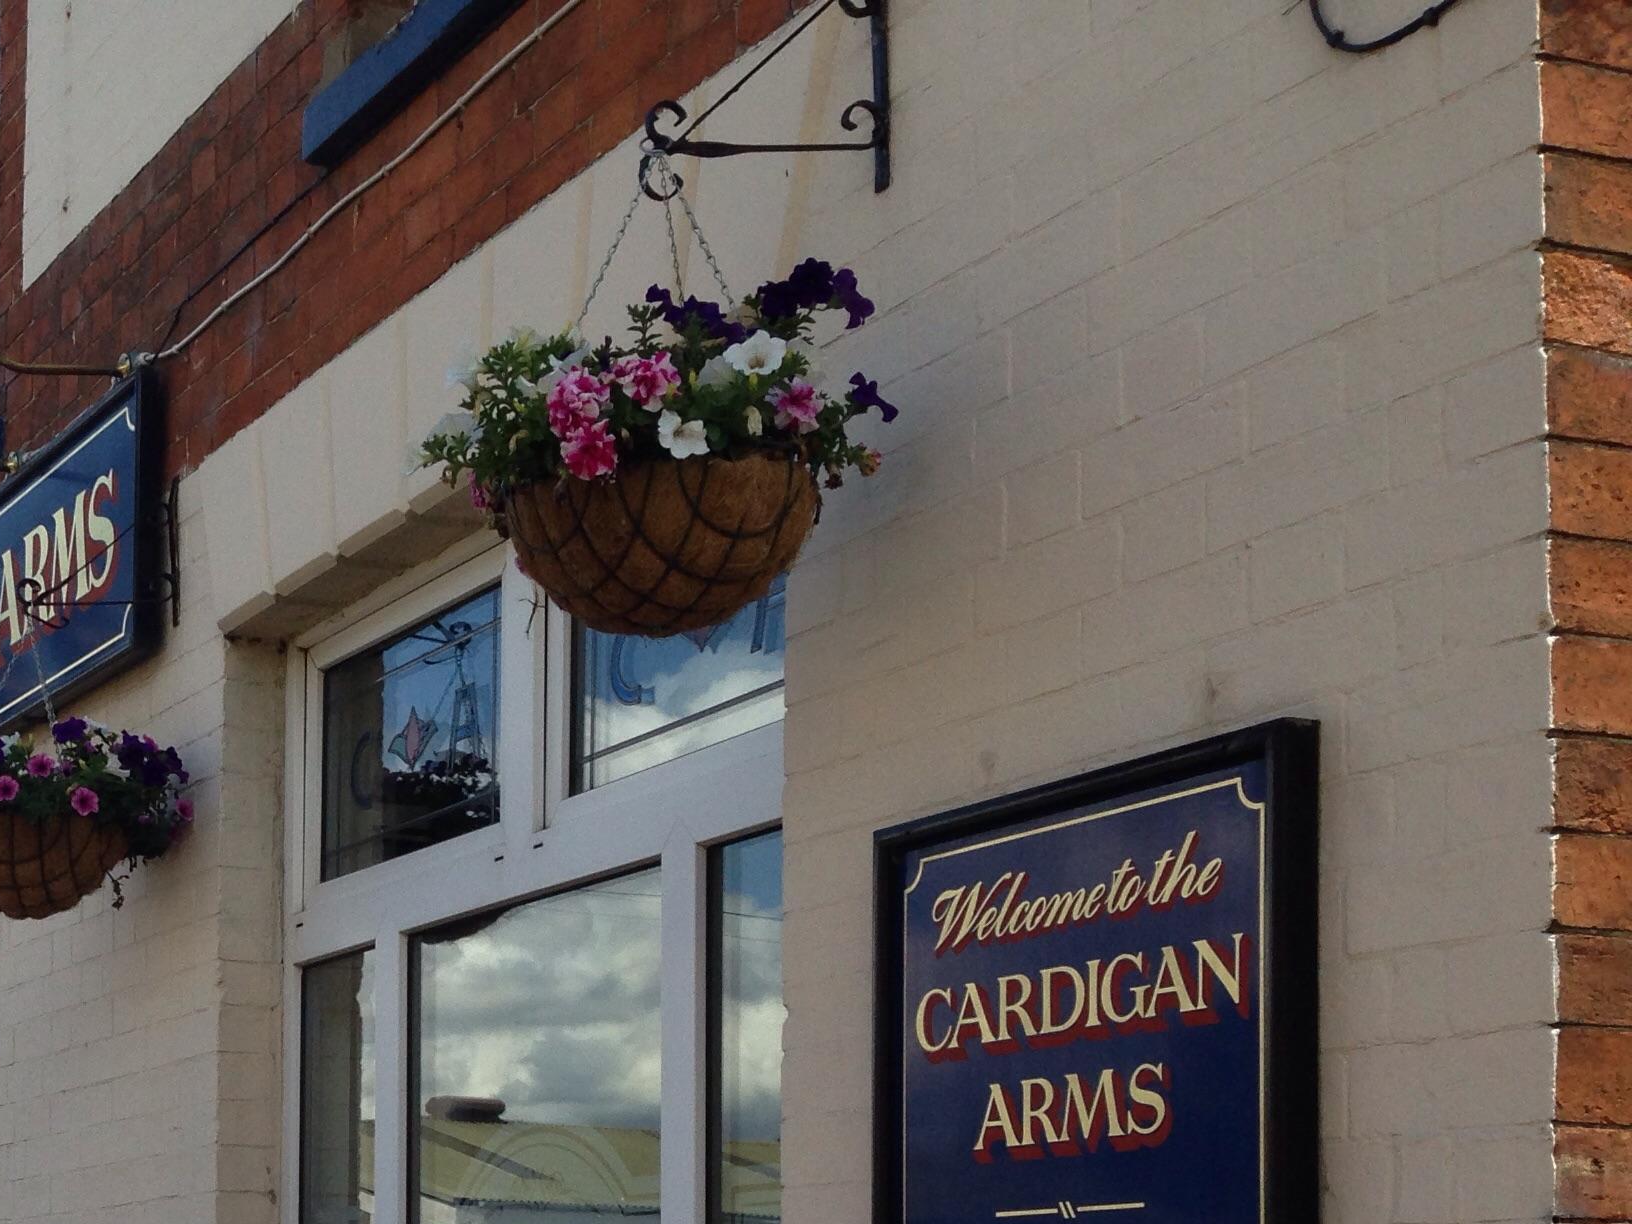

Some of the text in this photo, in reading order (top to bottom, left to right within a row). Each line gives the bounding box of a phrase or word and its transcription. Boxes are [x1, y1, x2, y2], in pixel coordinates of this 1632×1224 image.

[932, 829, 1224, 951] Welcome to the
[916, 932, 1244, 1053] CARDIGAN
[973, 1062, 1167, 1151] ARMS
